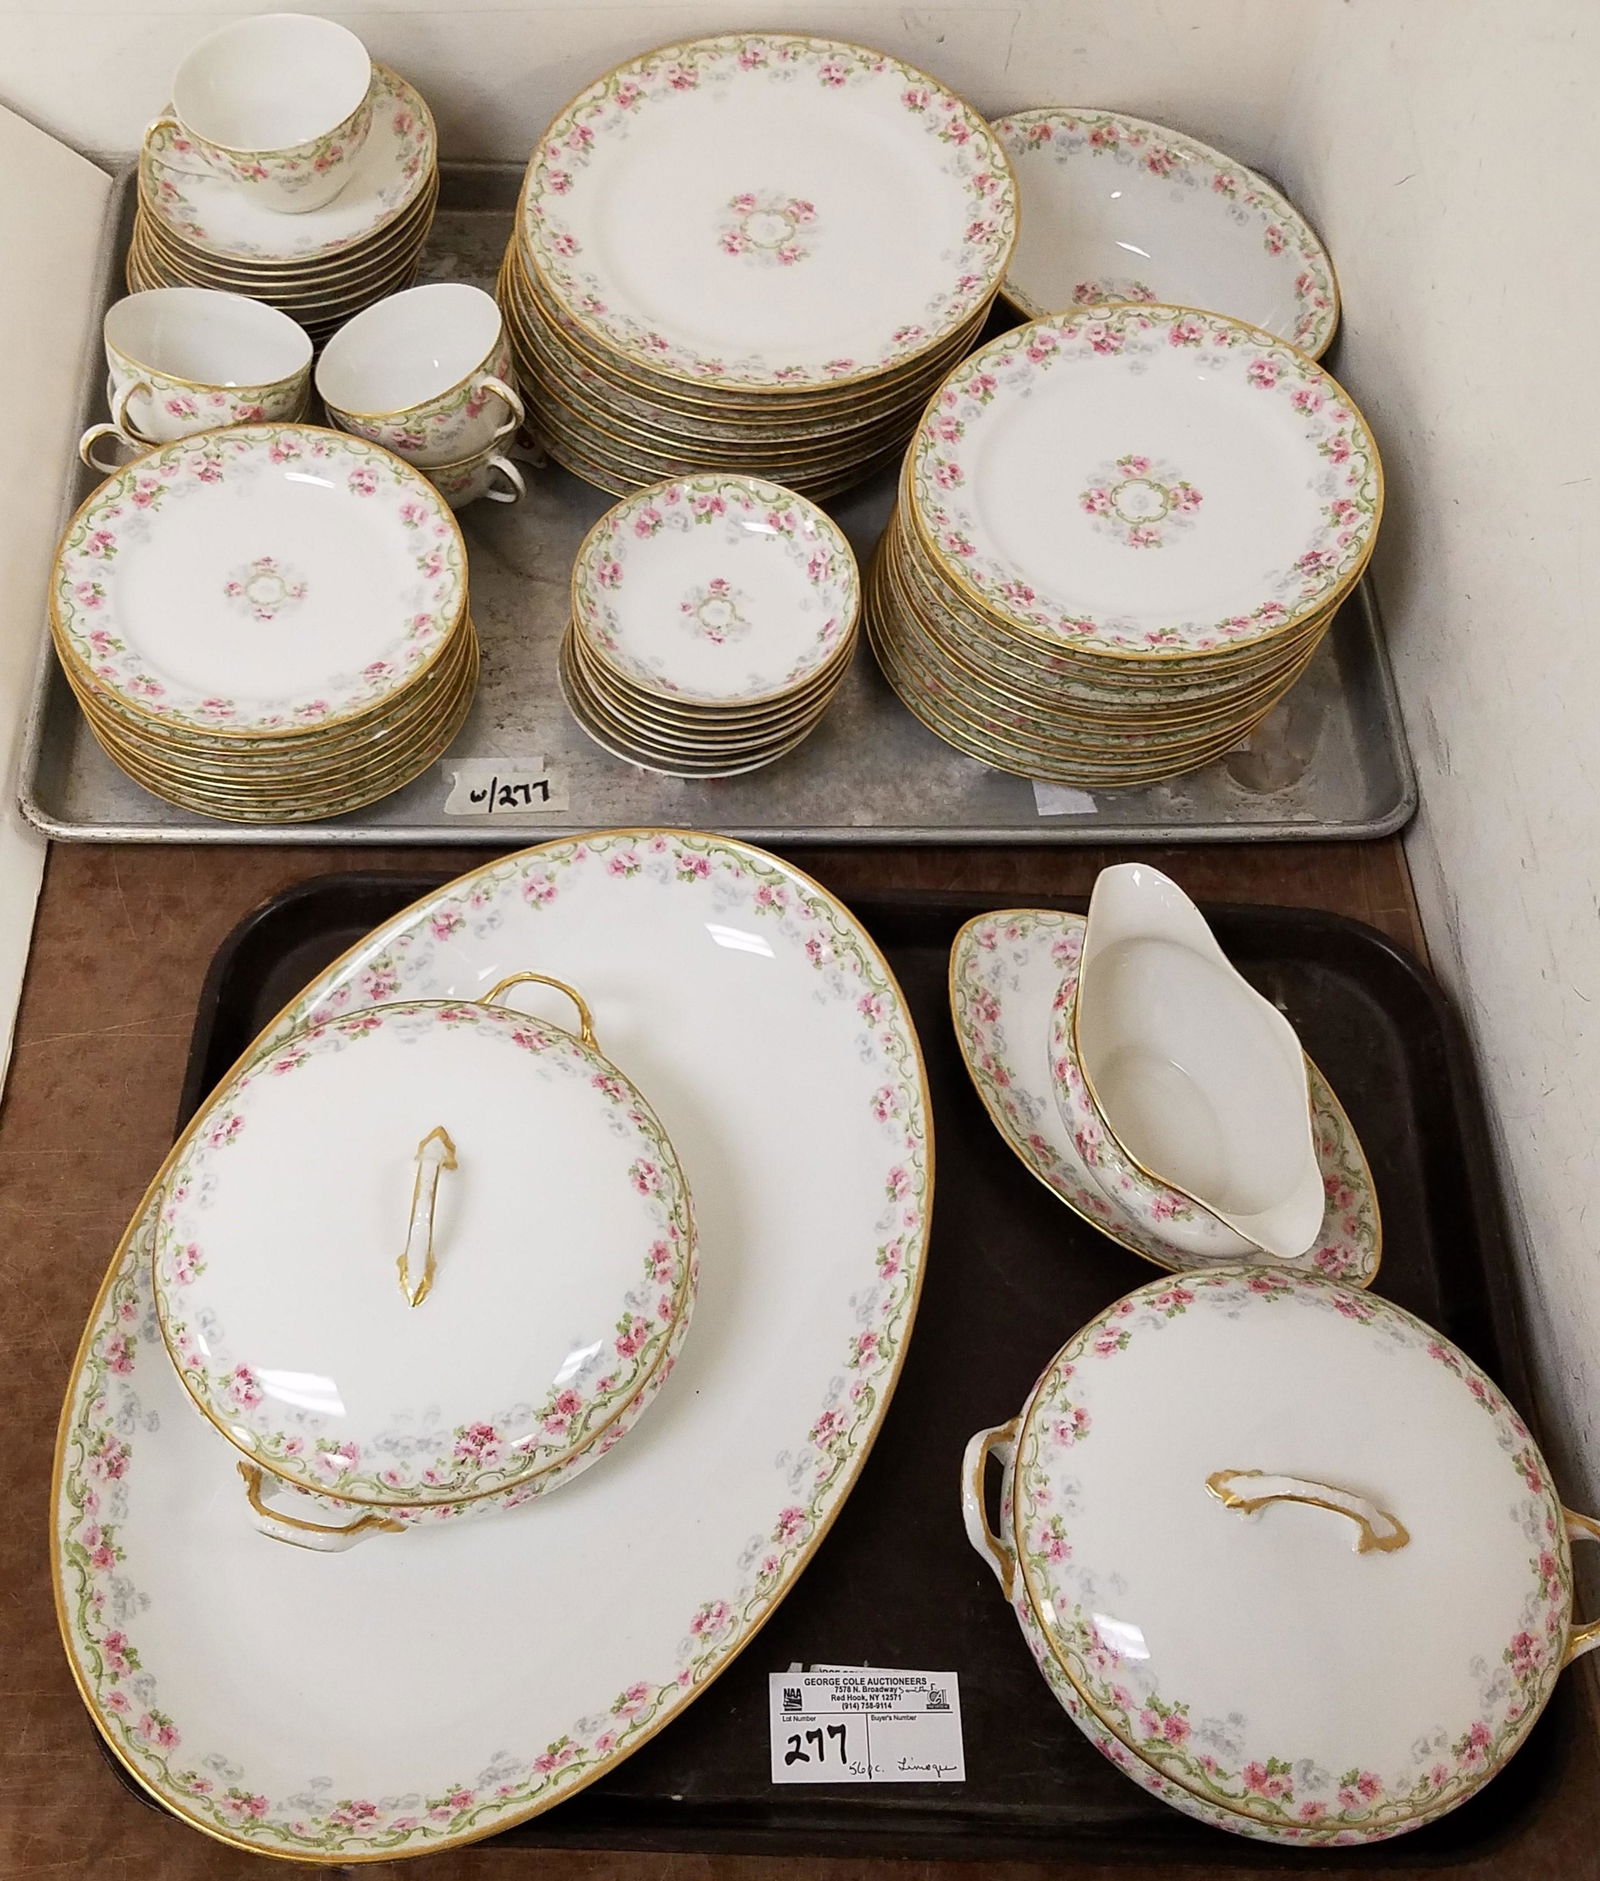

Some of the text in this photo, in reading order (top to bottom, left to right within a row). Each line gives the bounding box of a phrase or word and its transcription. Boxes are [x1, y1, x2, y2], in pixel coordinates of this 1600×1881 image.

[470, 776, 550, 813] w/277
[804, 1677, 927, 1686] GEORGE COLE AUCTIONEERS
[862, 1686, 898, 1694] Broadway
[846, 1694, 868, 1702] Hook,
[841, 1702, 860, 1710] (914)
[784, 1723, 847, 1766] 277
